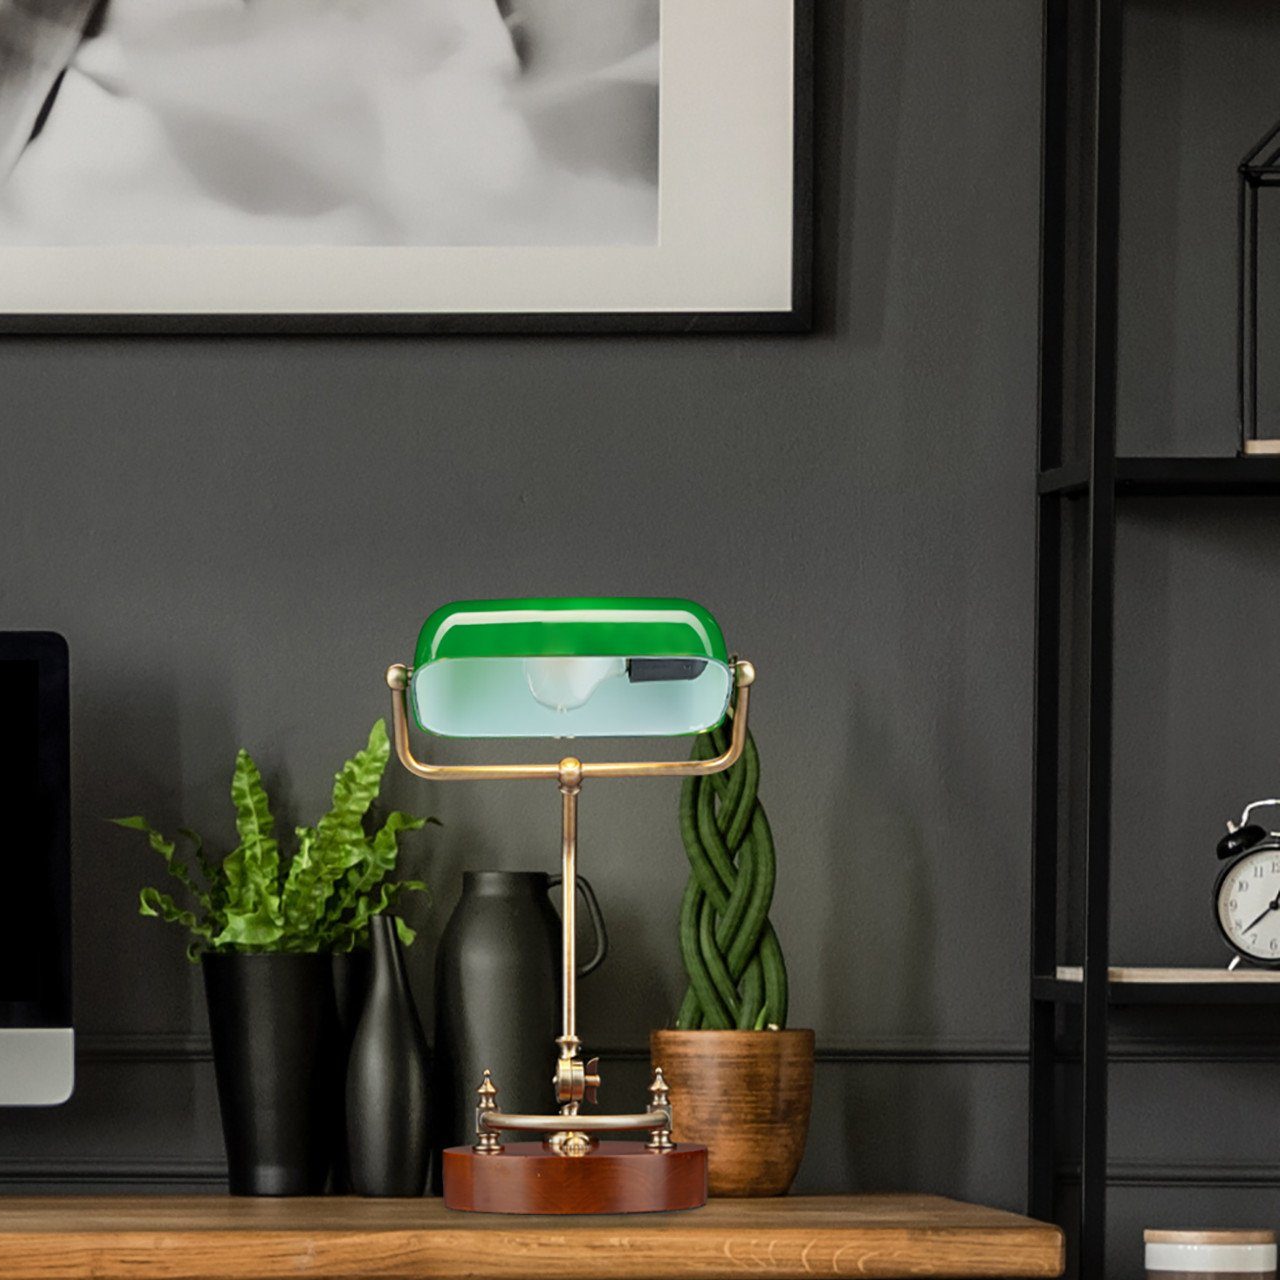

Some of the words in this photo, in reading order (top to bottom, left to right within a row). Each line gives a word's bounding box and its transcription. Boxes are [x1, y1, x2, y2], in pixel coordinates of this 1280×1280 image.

[1254, 865, 1263, 877] 11
[1238, 881, 1249, 893] 10
[1229, 899, 1238, 911] 9
[1250, 932, 1258, 944] 7
[1269, 938, 1278, 950] 6
